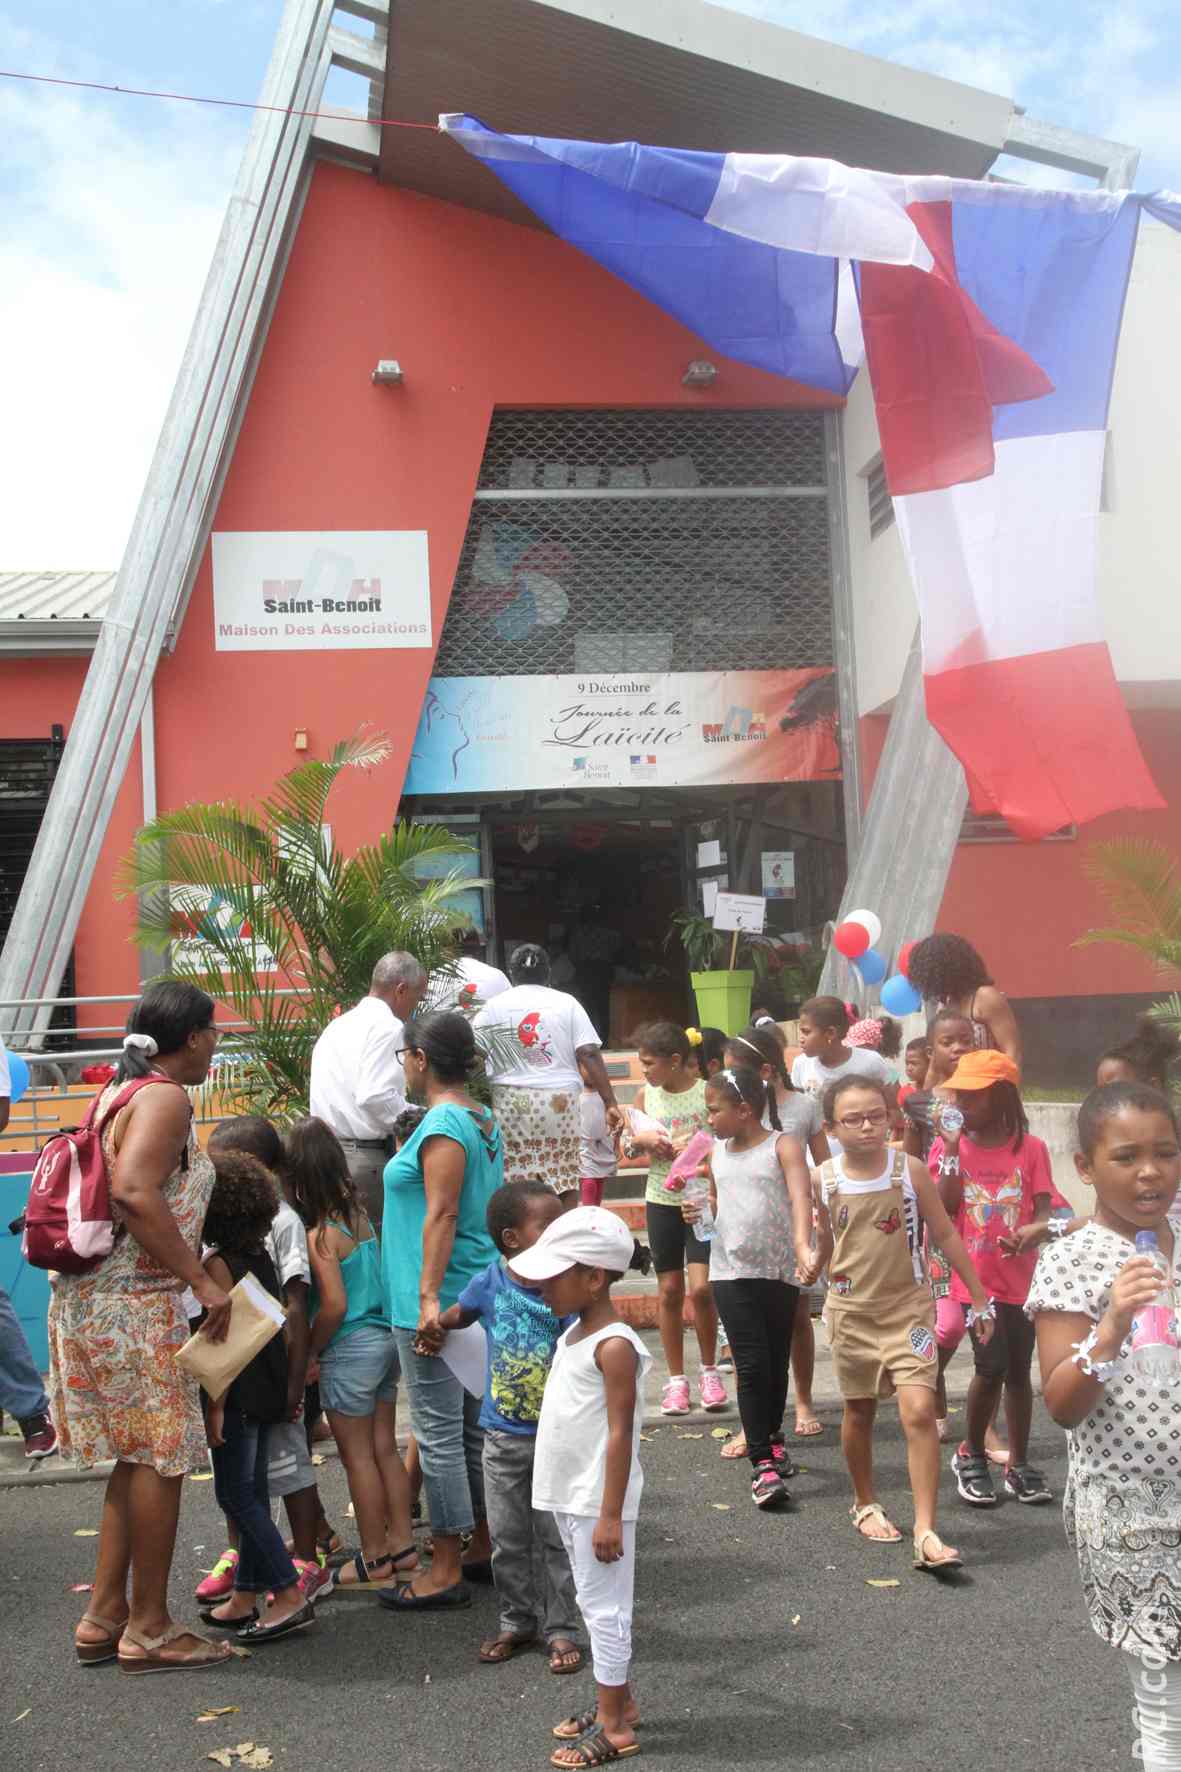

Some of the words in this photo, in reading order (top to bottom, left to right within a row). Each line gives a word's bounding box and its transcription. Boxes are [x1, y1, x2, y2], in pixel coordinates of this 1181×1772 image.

[219, 624, 278, 637] Maison
[285, 623, 315, 635] Des
[321, 621, 427, 635] Associations
[577, 682, 585, 693] 9
[589, 681, 650, 693] Décembre
[549, 704, 633, 723] Journée
[638, 702, 657, 716] de
[663, 701, 683, 716] la
[541, 719, 691, 748] Laïcité
